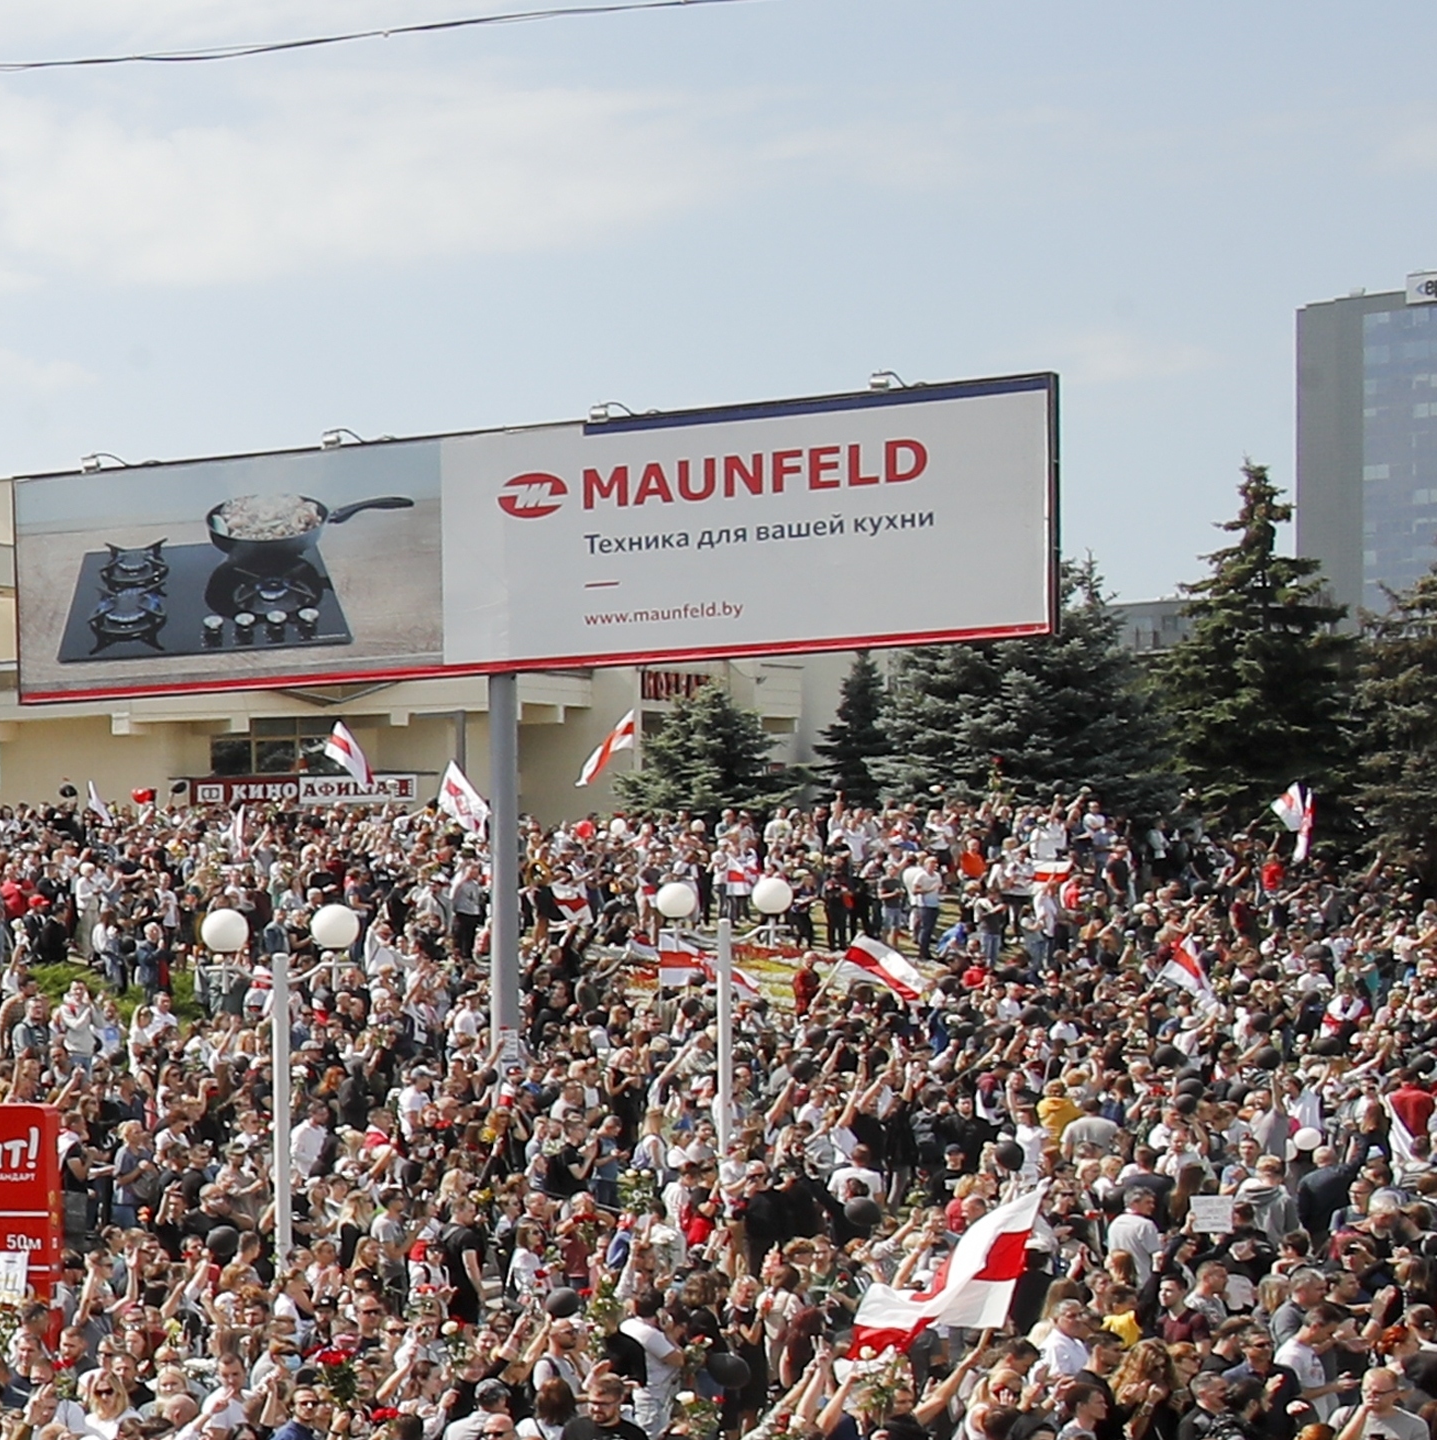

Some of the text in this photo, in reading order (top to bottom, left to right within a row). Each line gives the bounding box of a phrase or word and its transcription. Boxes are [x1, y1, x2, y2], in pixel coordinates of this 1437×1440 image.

[583, 438, 928, 510] MAUNFELD
[584, 510, 935, 555] Техника для вашей кухни
[584, 602, 743, 626] www.maunfeld.by
[231, 783, 298, 800] КИНО
